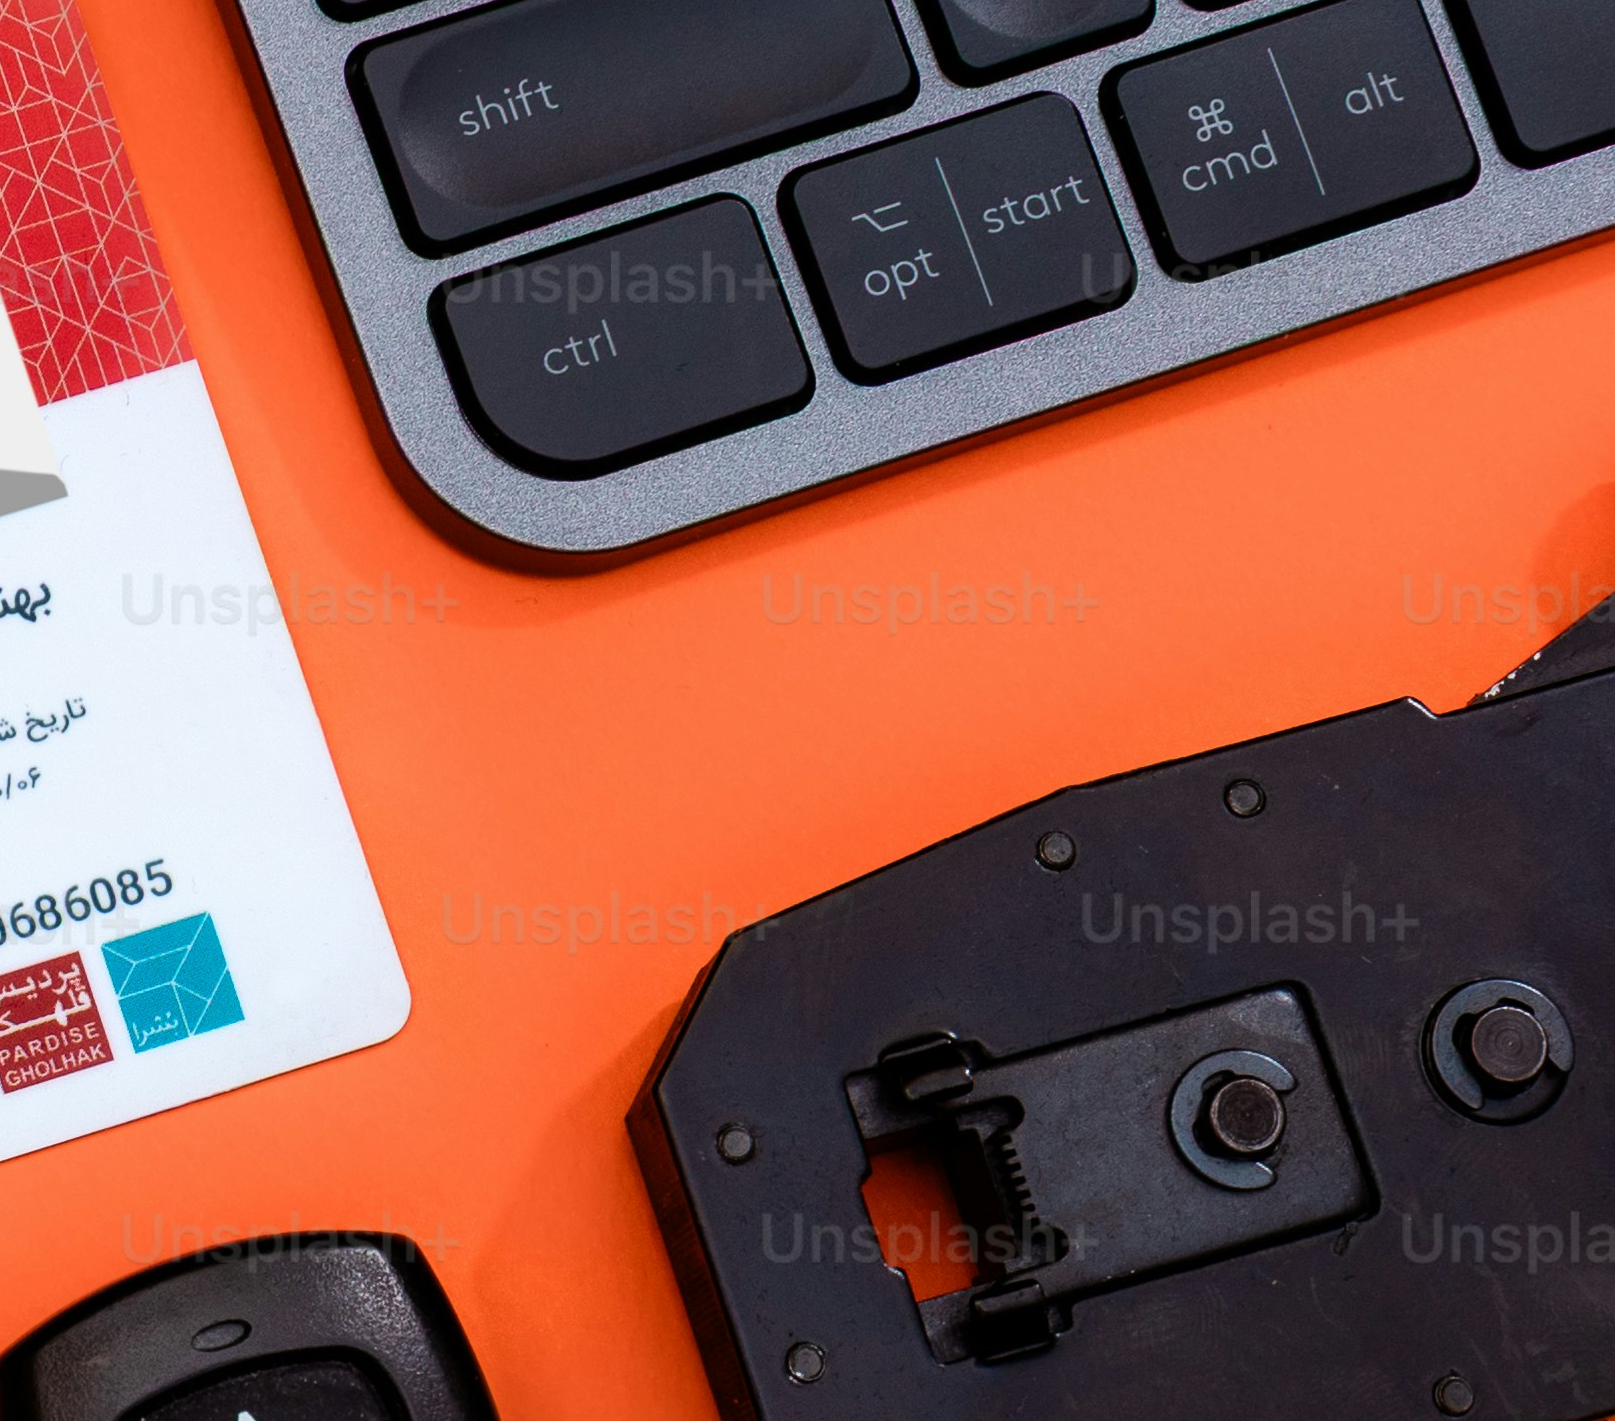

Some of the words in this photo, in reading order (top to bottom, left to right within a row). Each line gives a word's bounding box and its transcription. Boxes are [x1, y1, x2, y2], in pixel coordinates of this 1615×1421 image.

[458, 78, 559, 136] shift
[1345, 71, 1404, 115] alt
[1181, 130, 1279, 193] cmd
[982, 175, 1090, 234] start
[864, 248, 940, 301] opt
[543, 319, 617, 375] ctrl
[25, 696, 87, 743] تاریخ
[4, 1042, 107, 1087] GHOLHAK
